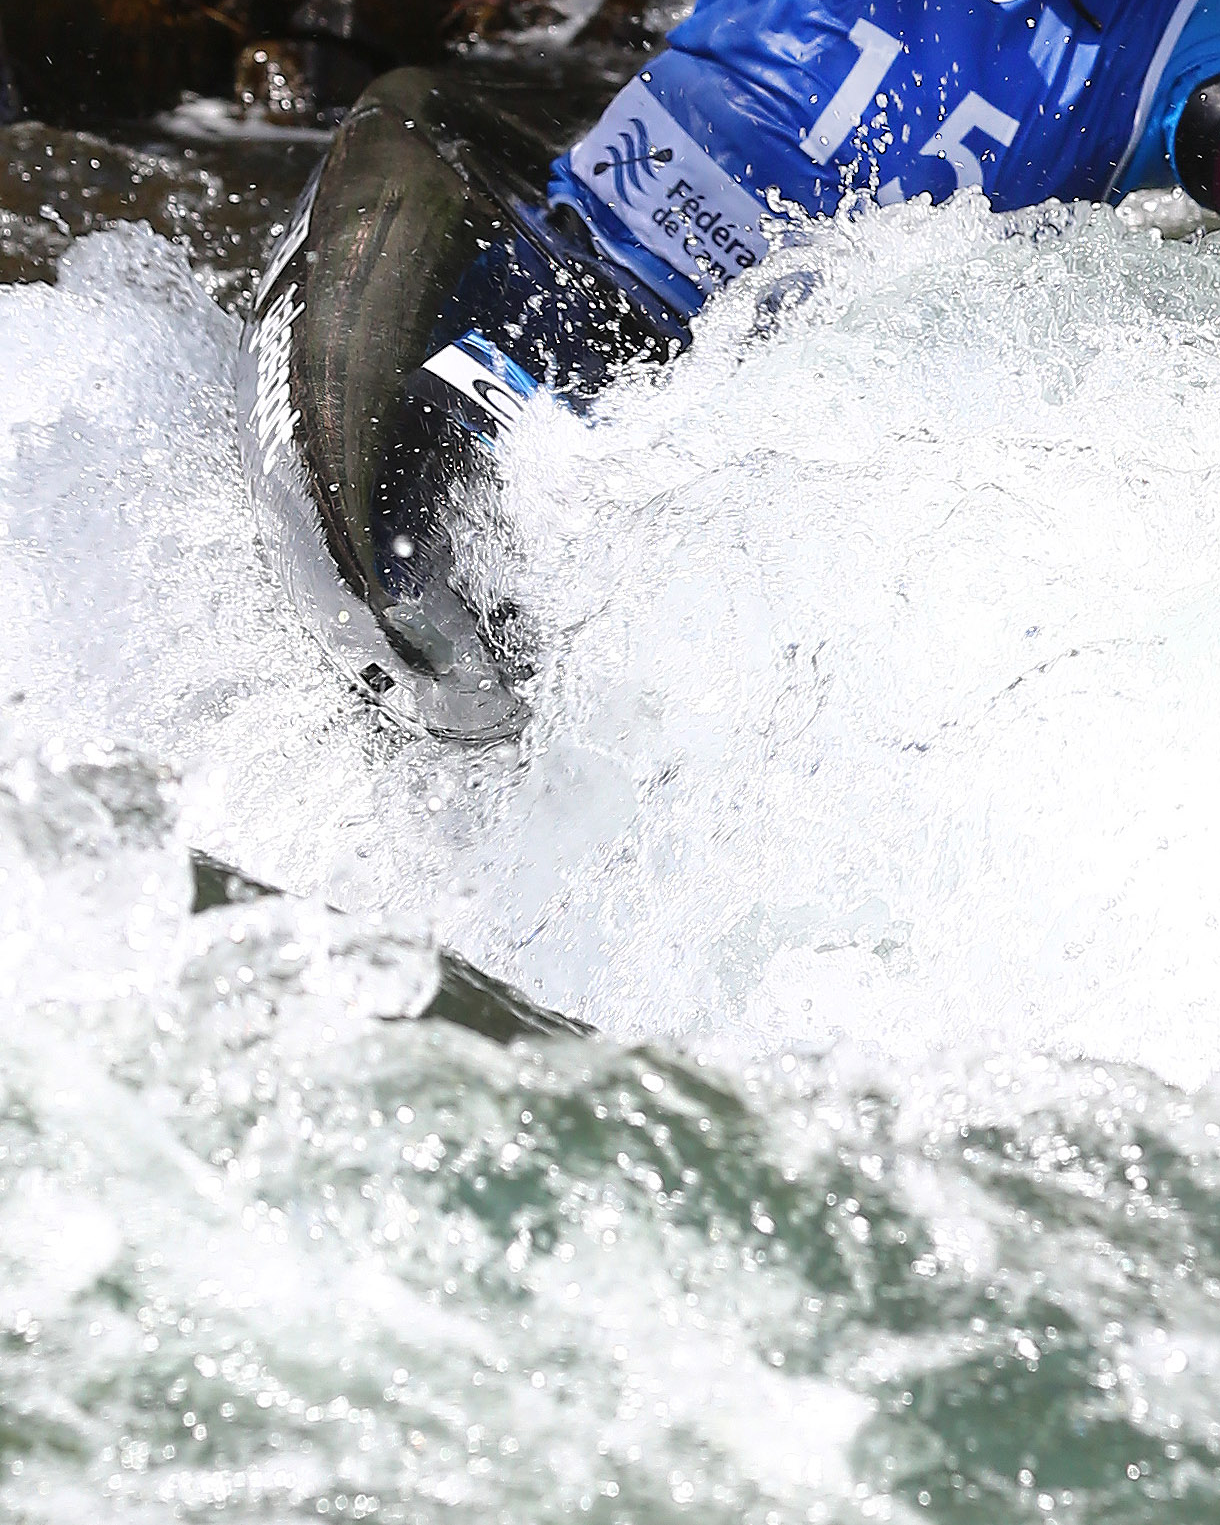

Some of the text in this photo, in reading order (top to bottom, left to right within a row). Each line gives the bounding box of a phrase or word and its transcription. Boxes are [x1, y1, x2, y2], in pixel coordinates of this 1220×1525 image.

[799, 17, 1020, 208] 15
[652, 208, 680, 238] de
[667, 179, 760, 268] Fédéra
